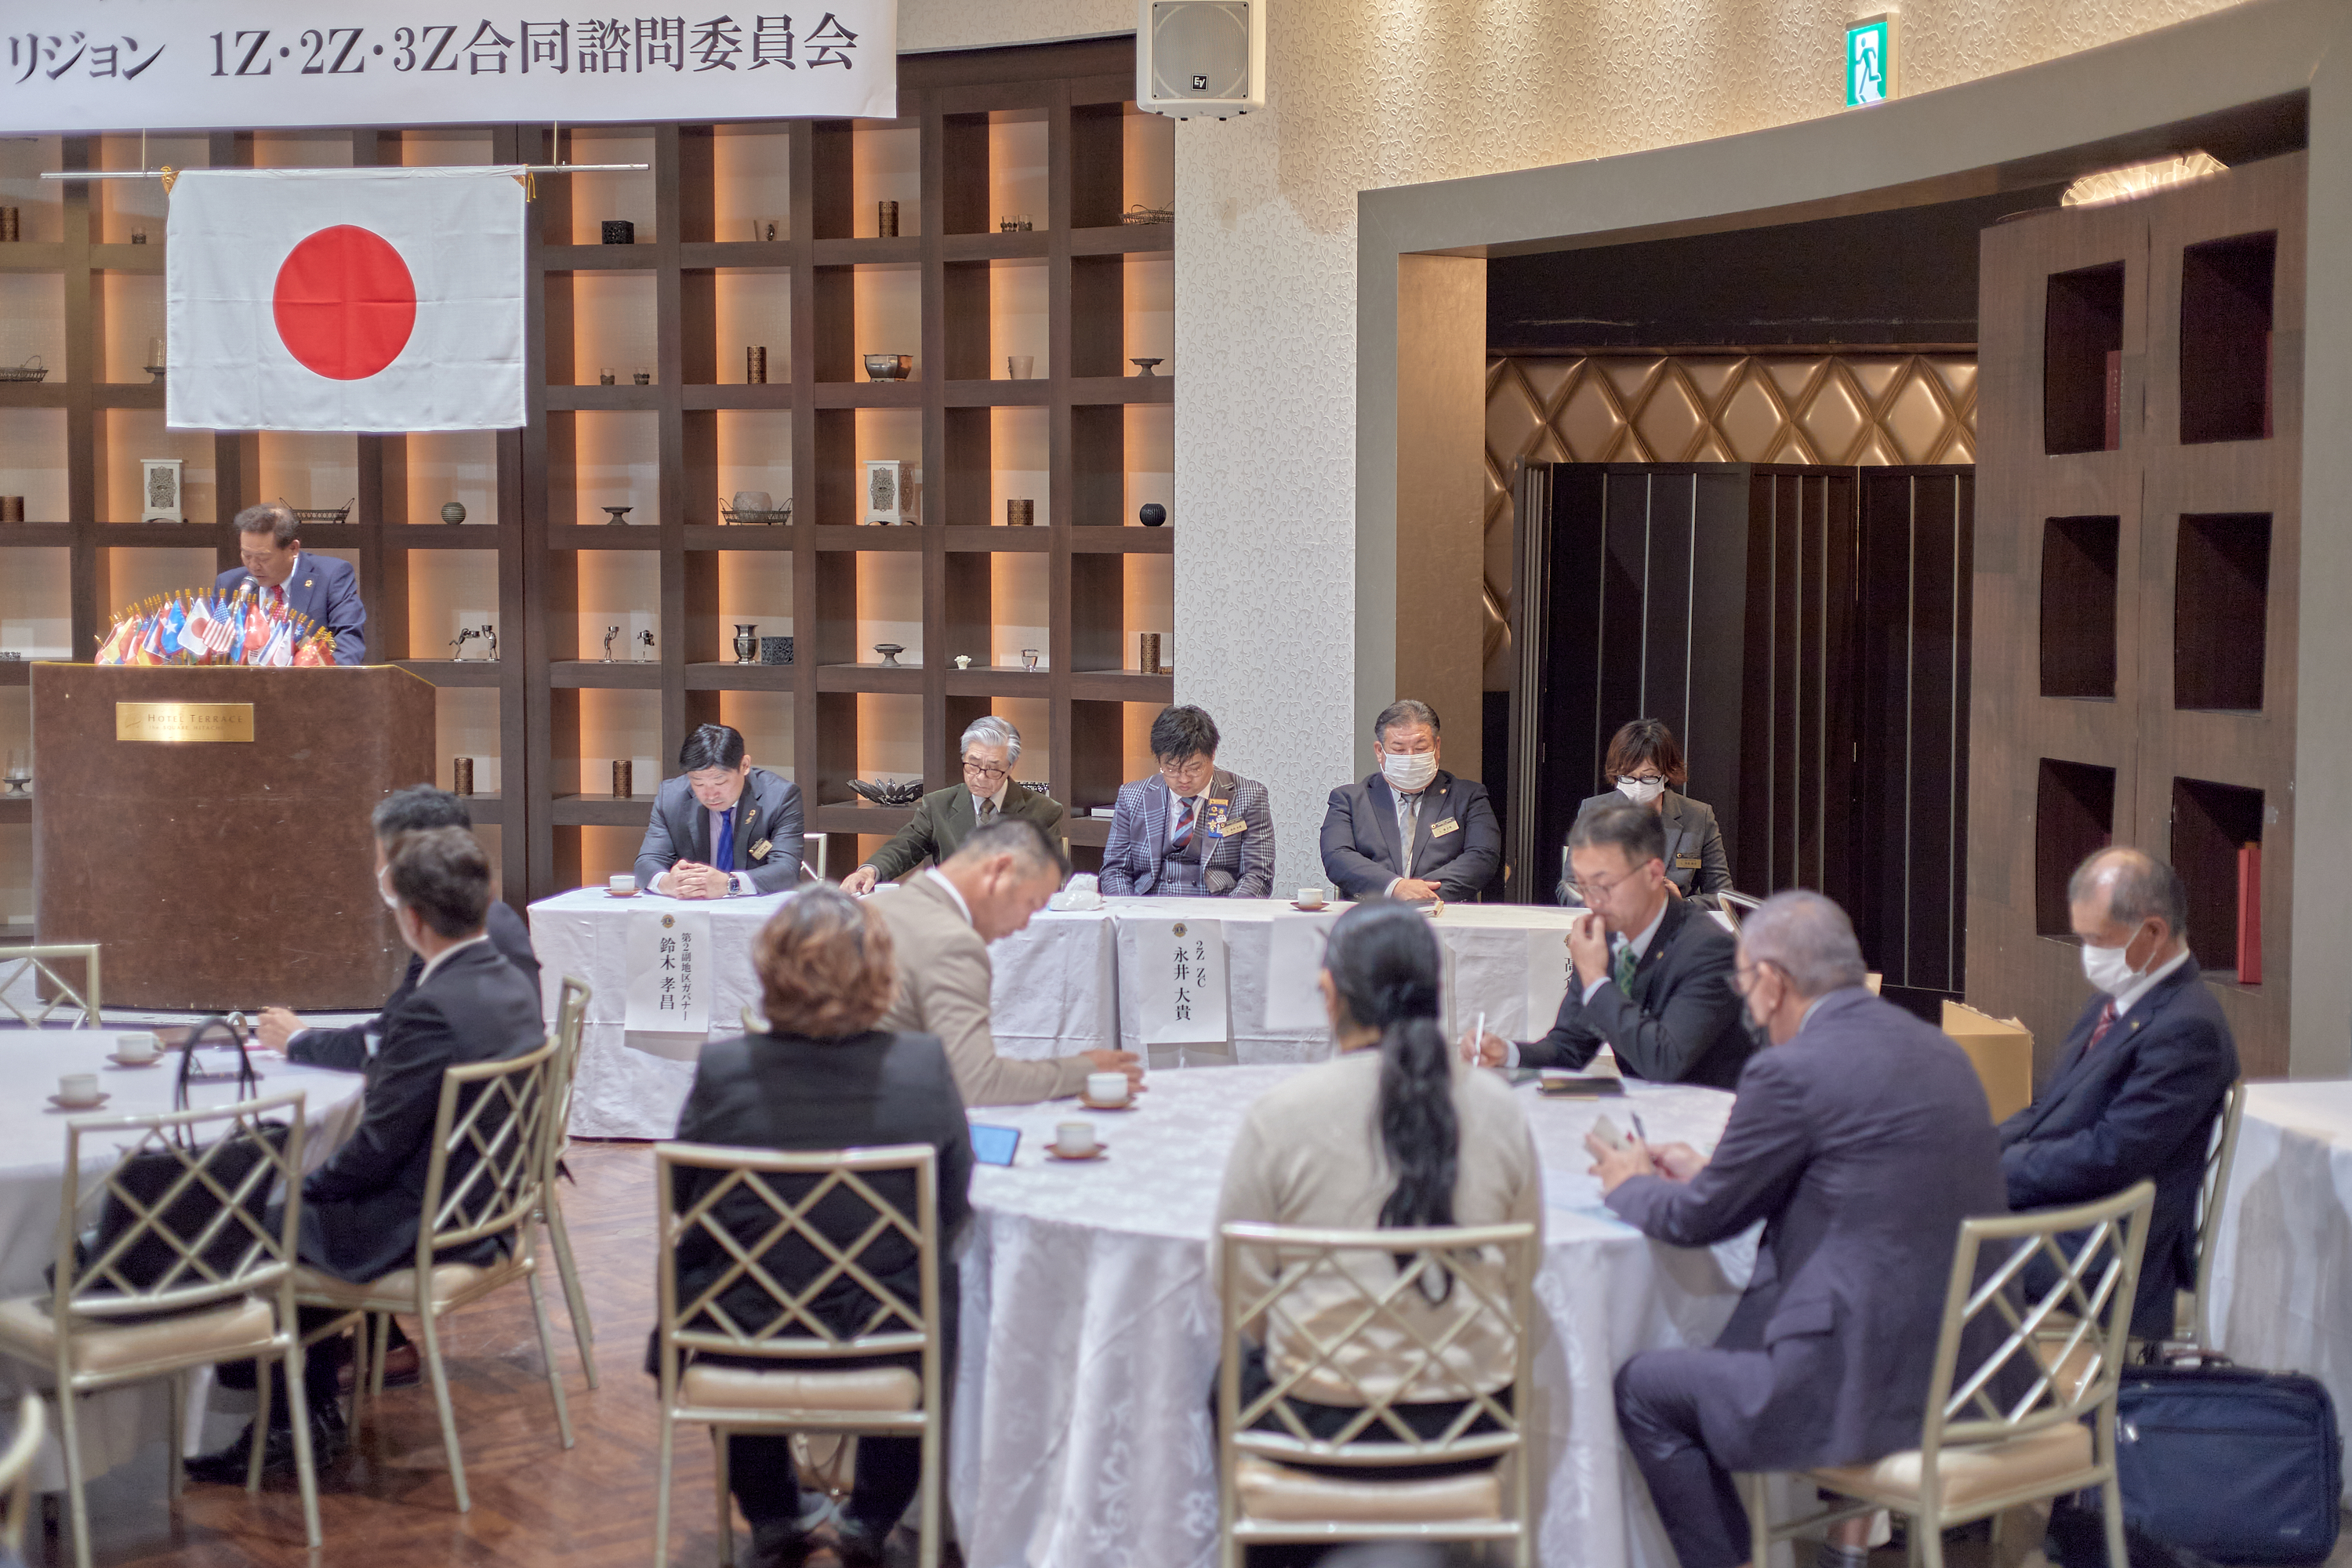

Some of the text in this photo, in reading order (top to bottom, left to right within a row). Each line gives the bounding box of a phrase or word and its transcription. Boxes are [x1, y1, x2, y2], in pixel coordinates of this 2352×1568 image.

[8, 31, 166, 85] リジョン
[147, 713, 243, 723] HOTEL TERRACE
[681, 932, 691, 1021] 第2副地区ガバナー
